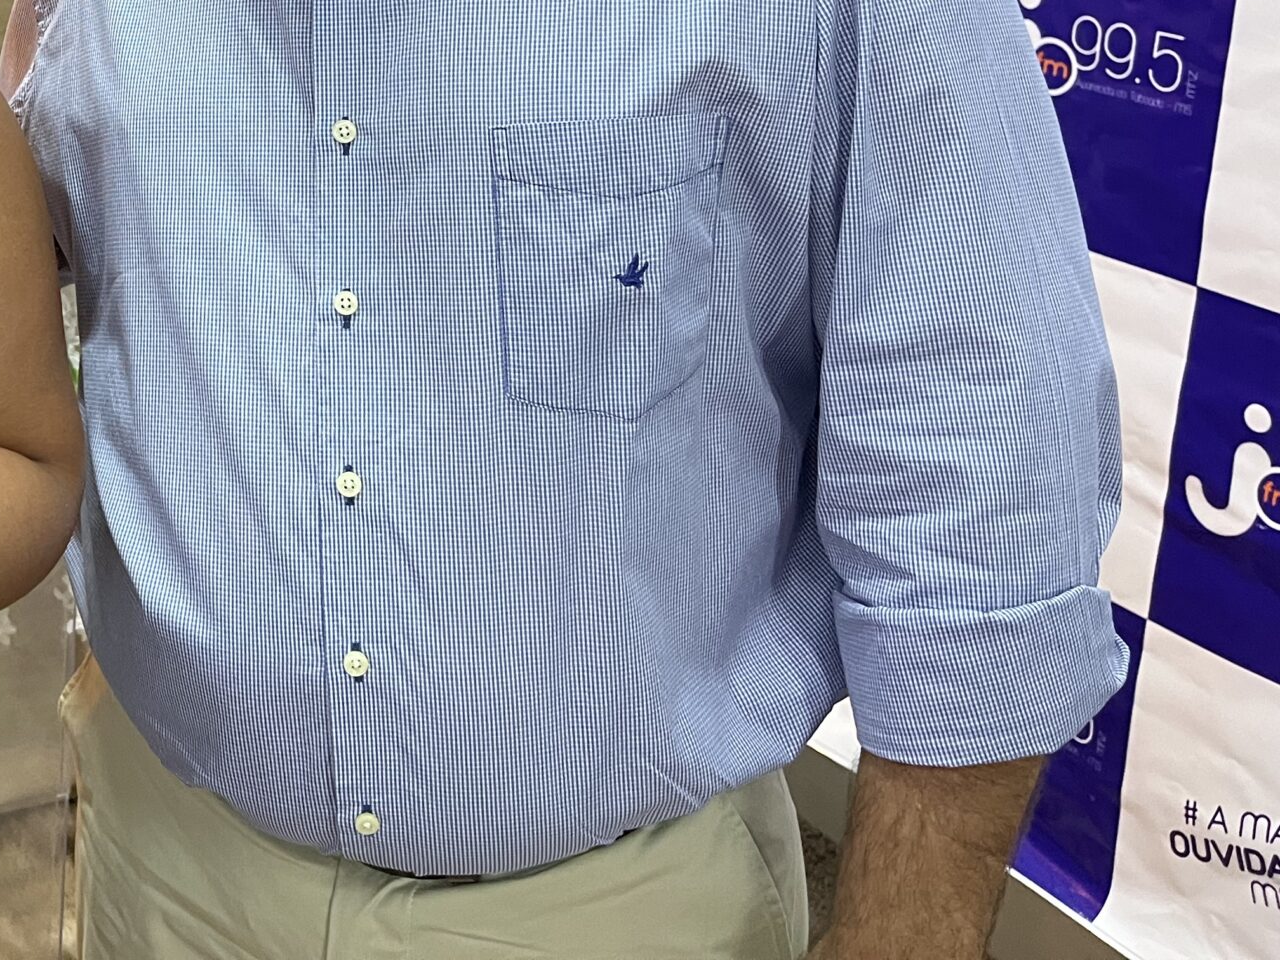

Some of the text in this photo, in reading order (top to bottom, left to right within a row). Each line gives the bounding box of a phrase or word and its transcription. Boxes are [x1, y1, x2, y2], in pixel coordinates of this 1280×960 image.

[1071, 15, 1186, 93] 99.5
[1184, 799, 1198, 826] #
[1207, 806, 1228, 834] A
